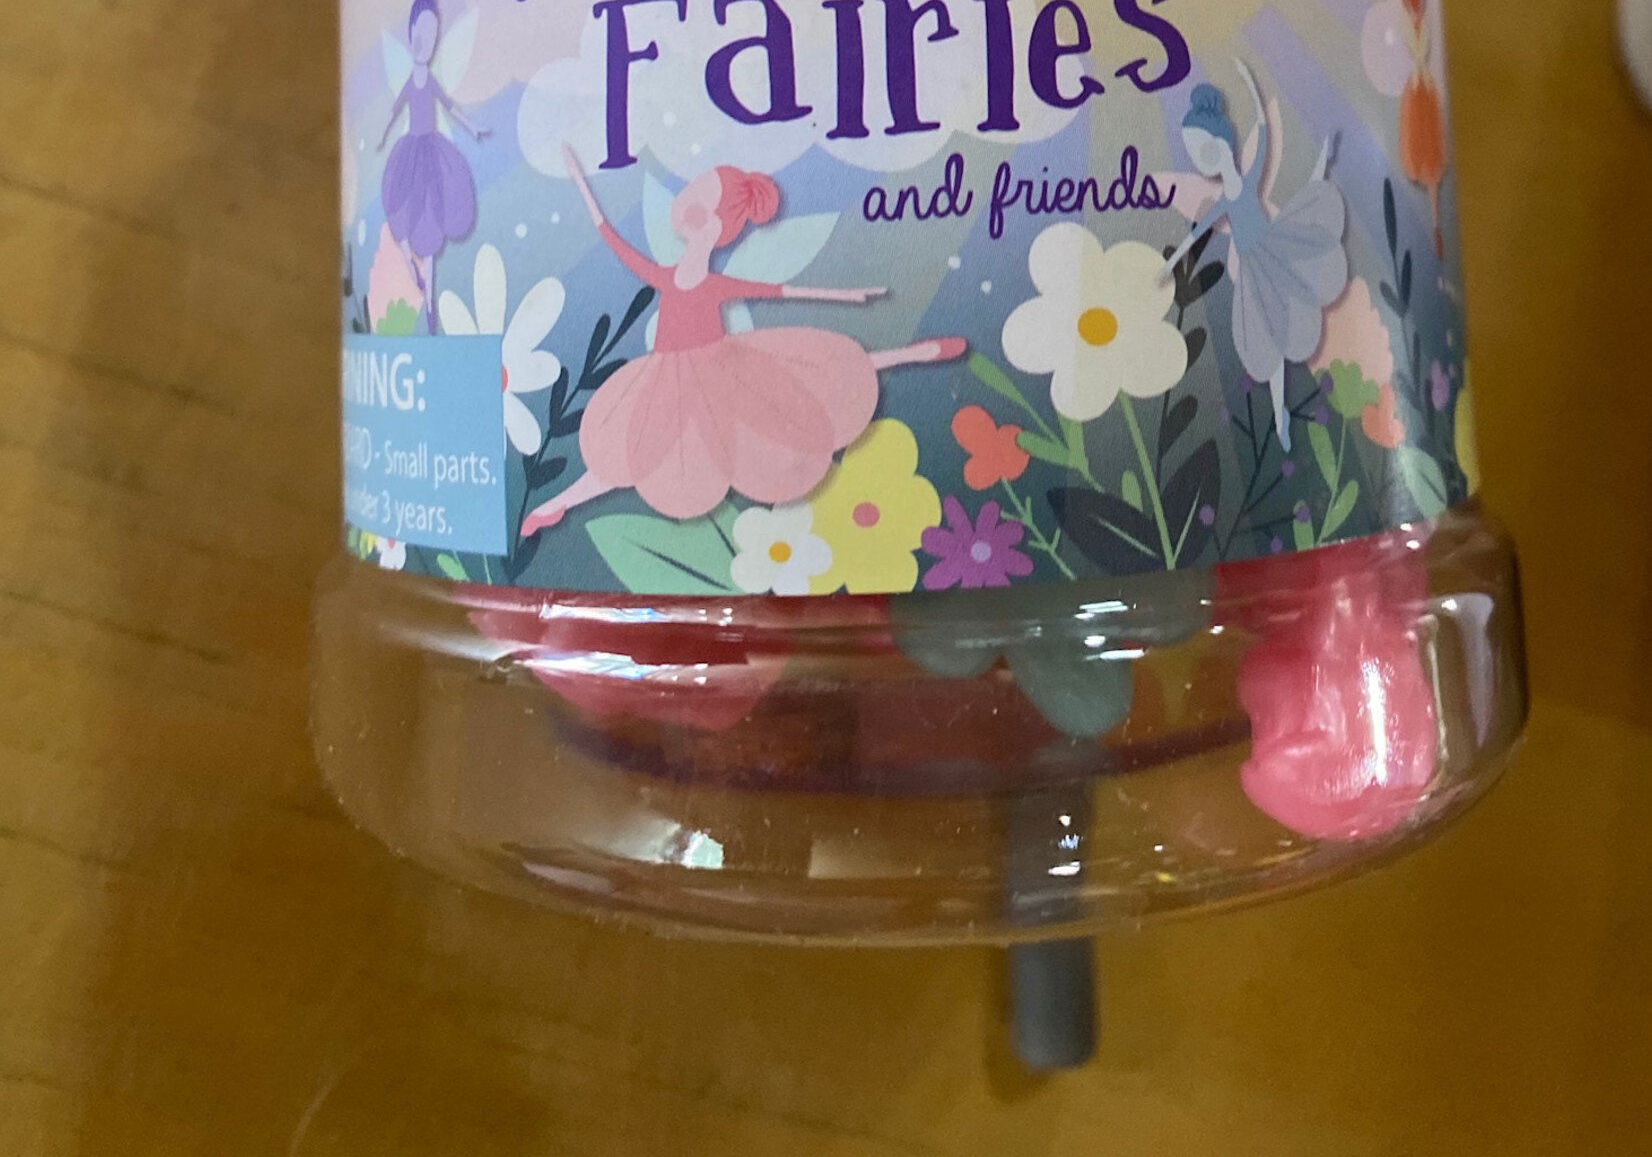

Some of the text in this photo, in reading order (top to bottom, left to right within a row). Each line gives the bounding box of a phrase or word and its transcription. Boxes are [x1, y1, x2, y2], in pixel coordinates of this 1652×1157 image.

[863, 146, 1176, 240] and friends
[385, 440, 428, 478] Small
[434, 451, 497, 490] parts.
[382, 490, 391, 524] 3
[395, 499, 453, 536] years.
